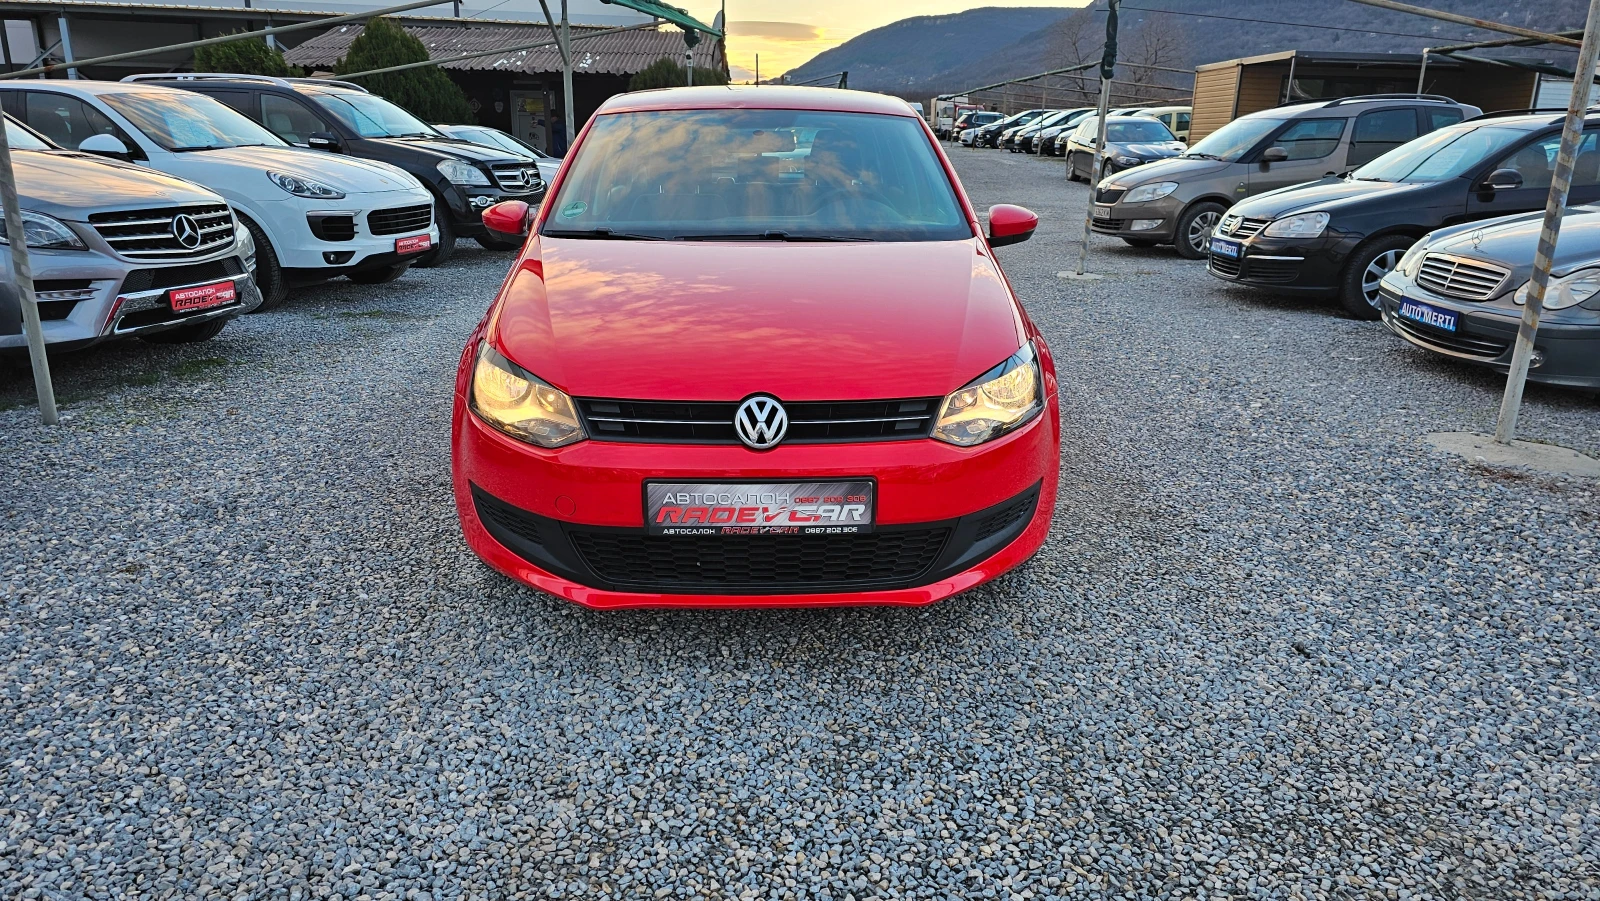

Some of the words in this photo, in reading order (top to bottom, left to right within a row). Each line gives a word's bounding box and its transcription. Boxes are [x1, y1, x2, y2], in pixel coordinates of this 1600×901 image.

[175, 288, 216, 300] АВТОСАЛОН
[1401, 302, 1422, 320] AUTO
[1422, 310, 1455, 330] MERTI
[662, 492, 790, 505] АВТОСАЛОН
